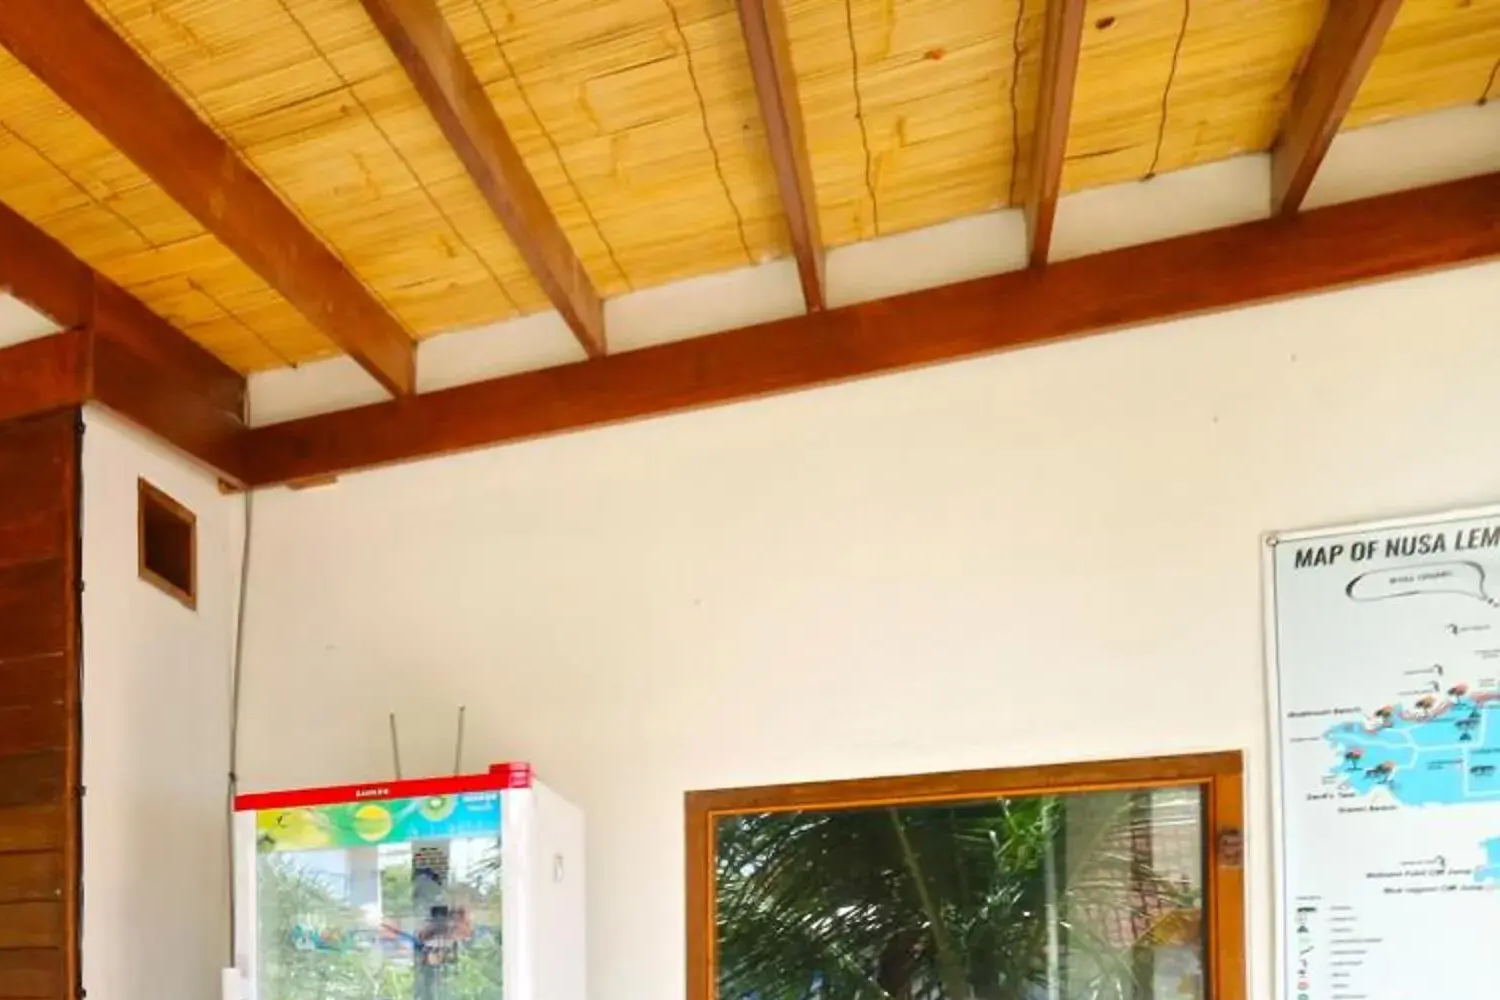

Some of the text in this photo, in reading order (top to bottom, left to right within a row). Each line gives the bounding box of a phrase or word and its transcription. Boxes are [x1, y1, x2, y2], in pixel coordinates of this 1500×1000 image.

[1295, 544, 1343, 568] MAP
[1350, 540, 1379, 561] OF
[1385, 533, 1446, 557] NUSA
